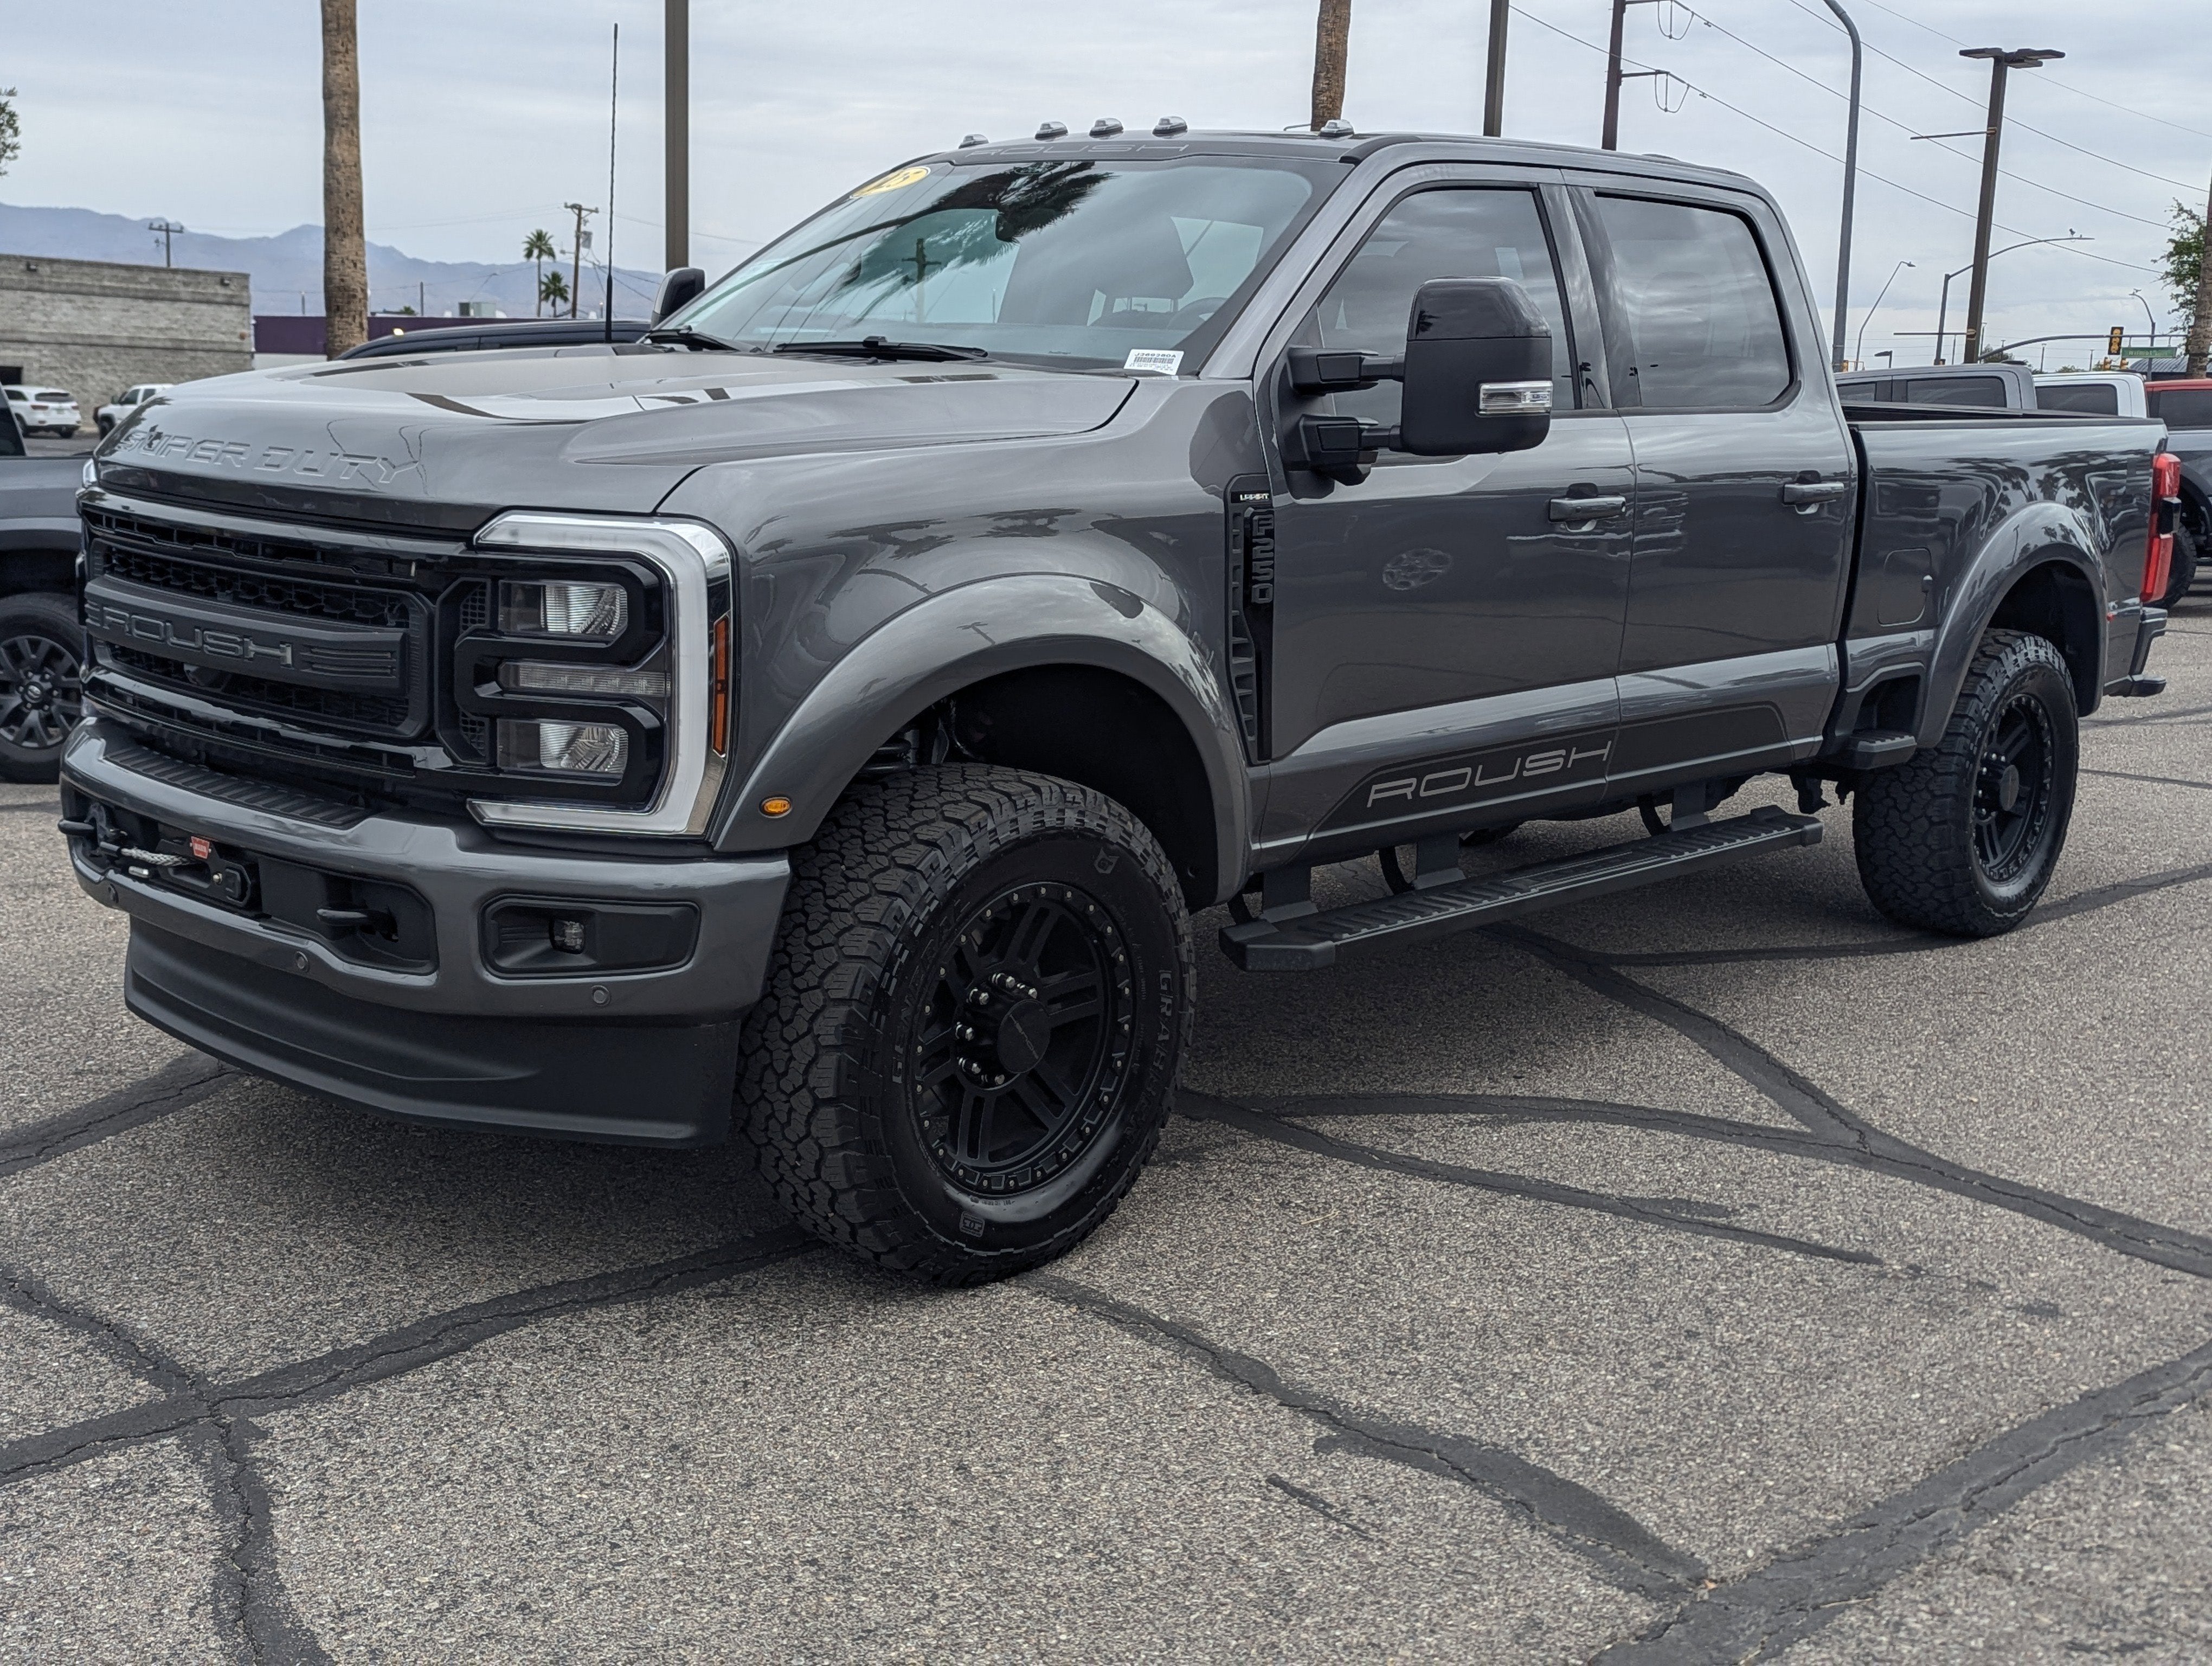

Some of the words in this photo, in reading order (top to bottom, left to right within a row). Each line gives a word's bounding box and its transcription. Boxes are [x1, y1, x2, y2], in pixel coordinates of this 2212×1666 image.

[965, 144, 1190, 158] ROUSH
[116, 430, 253, 467] SUPER
[253, 446, 419, 484] DUTY
[103, 606, 294, 669] ROUSH
[1366, 741, 1612, 808] ROUSH
